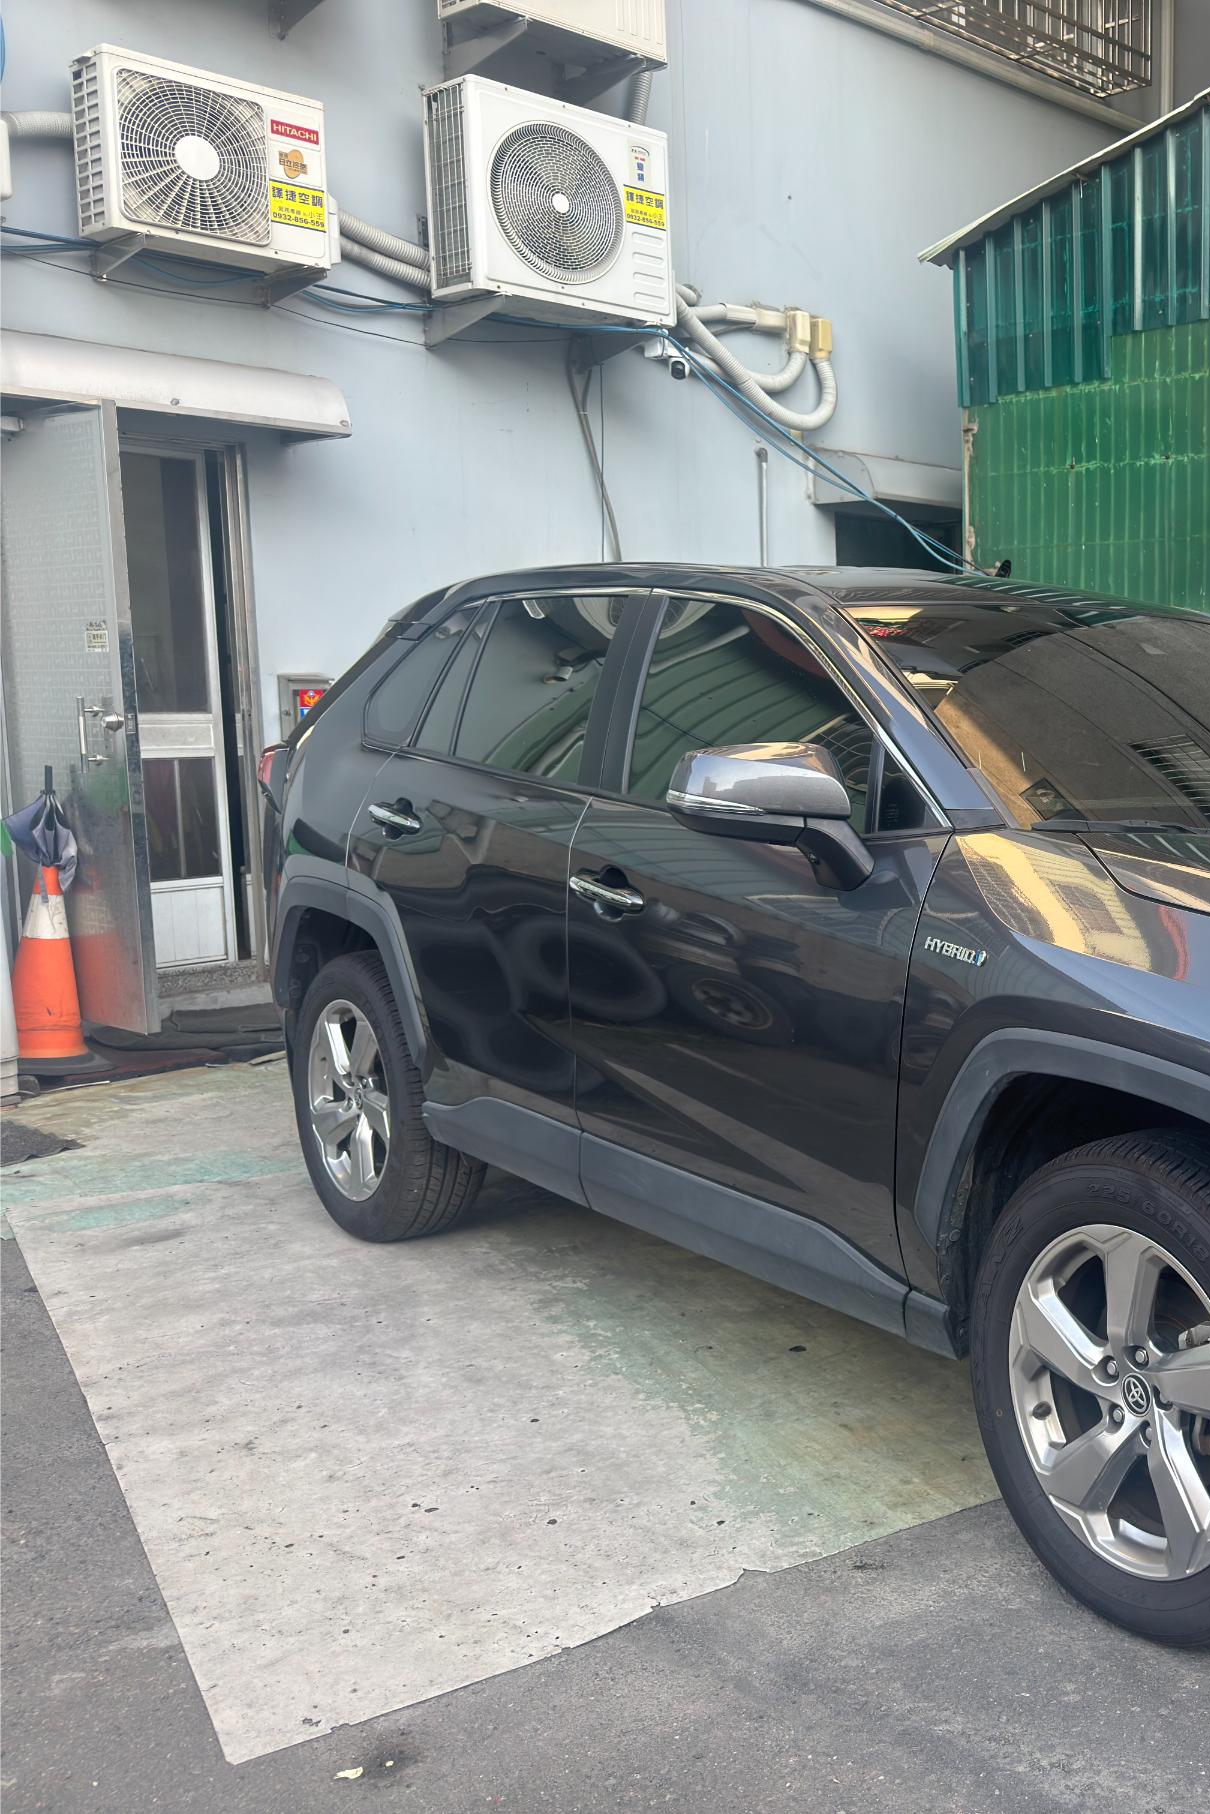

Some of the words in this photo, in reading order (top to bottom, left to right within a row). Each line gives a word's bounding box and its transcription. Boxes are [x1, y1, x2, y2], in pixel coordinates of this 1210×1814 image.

[273, 123, 317, 142] HITACHI
[273, 211, 325, 228] 0932-856-559
[924, 936, 976, 964] HYBRID
